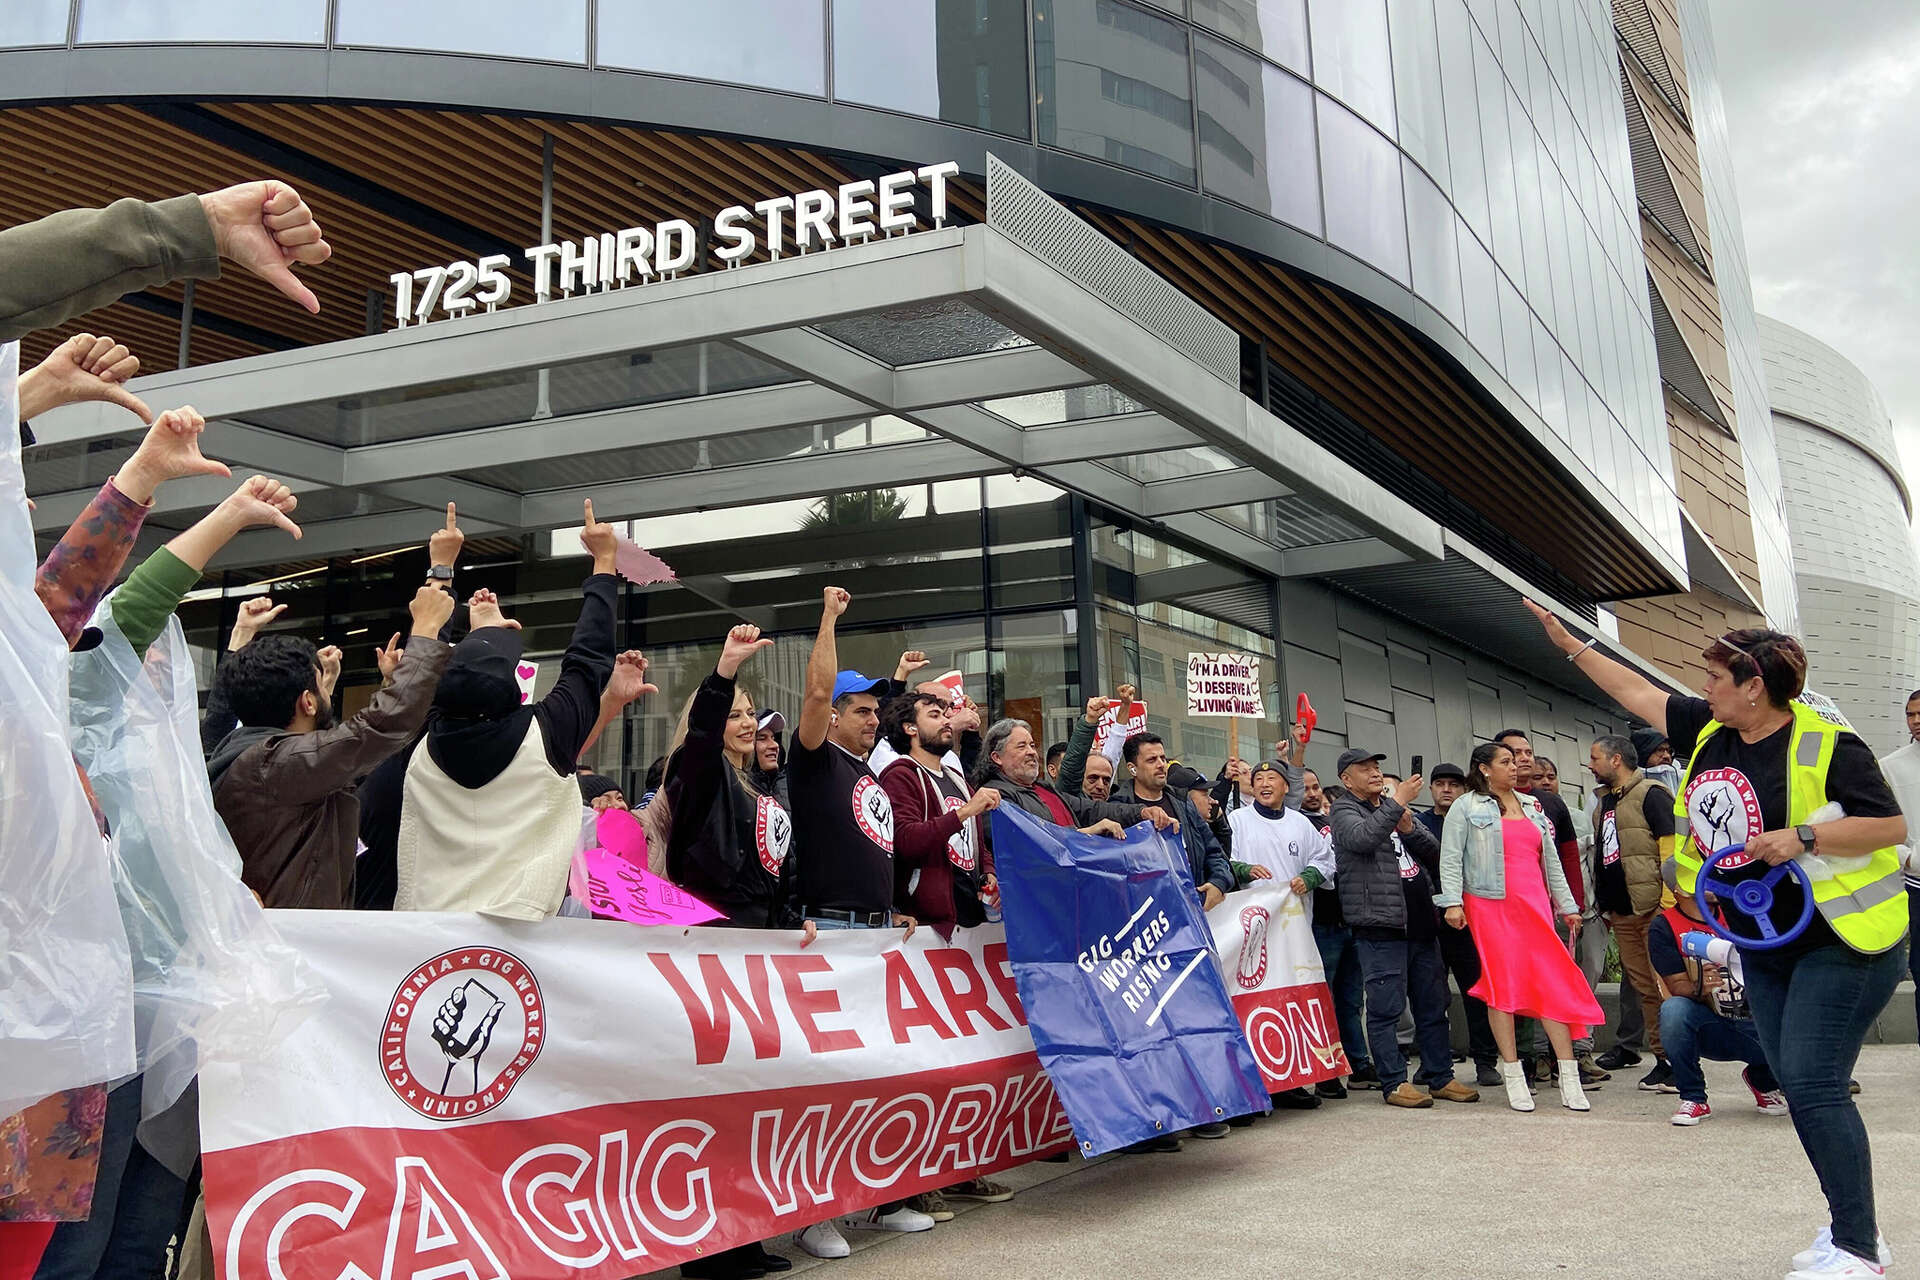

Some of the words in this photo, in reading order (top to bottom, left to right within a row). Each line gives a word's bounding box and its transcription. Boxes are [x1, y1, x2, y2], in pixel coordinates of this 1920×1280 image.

[390, 254, 512, 322] 1725
[525, 218, 697, 298] THIRD
[714, 160, 960, 260] STREET
[1195, 663, 1211, 676] I'M
[1212, 663, 1221, 677] A
[1205, 681, 1246, 695] DESERVE
[1246, 685, 1251, 697] A
[1198, 698, 1233, 713] LIVING
[1729, 772, 1746, 787] GIG
[1743, 791, 1760, 838] WORK
[1078, 934, 1112, 974] GIG
[1099, 910, 1171, 993] WORKERS
[1121, 950, 1172, 1014] RISING
[386, 958, 453, 1087] CALIFORNIA
[479, 953, 514, 975] GIG
[506, 974, 541, 1080] WORKERS
[647, 951, 867, 1066] WE
[423, 1095, 496, 1115] UNION
[226, 1156, 510, 1280] CA
[502, 1119, 718, 1269] GIG
[750, 1068, 1076, 1217] WORKE
